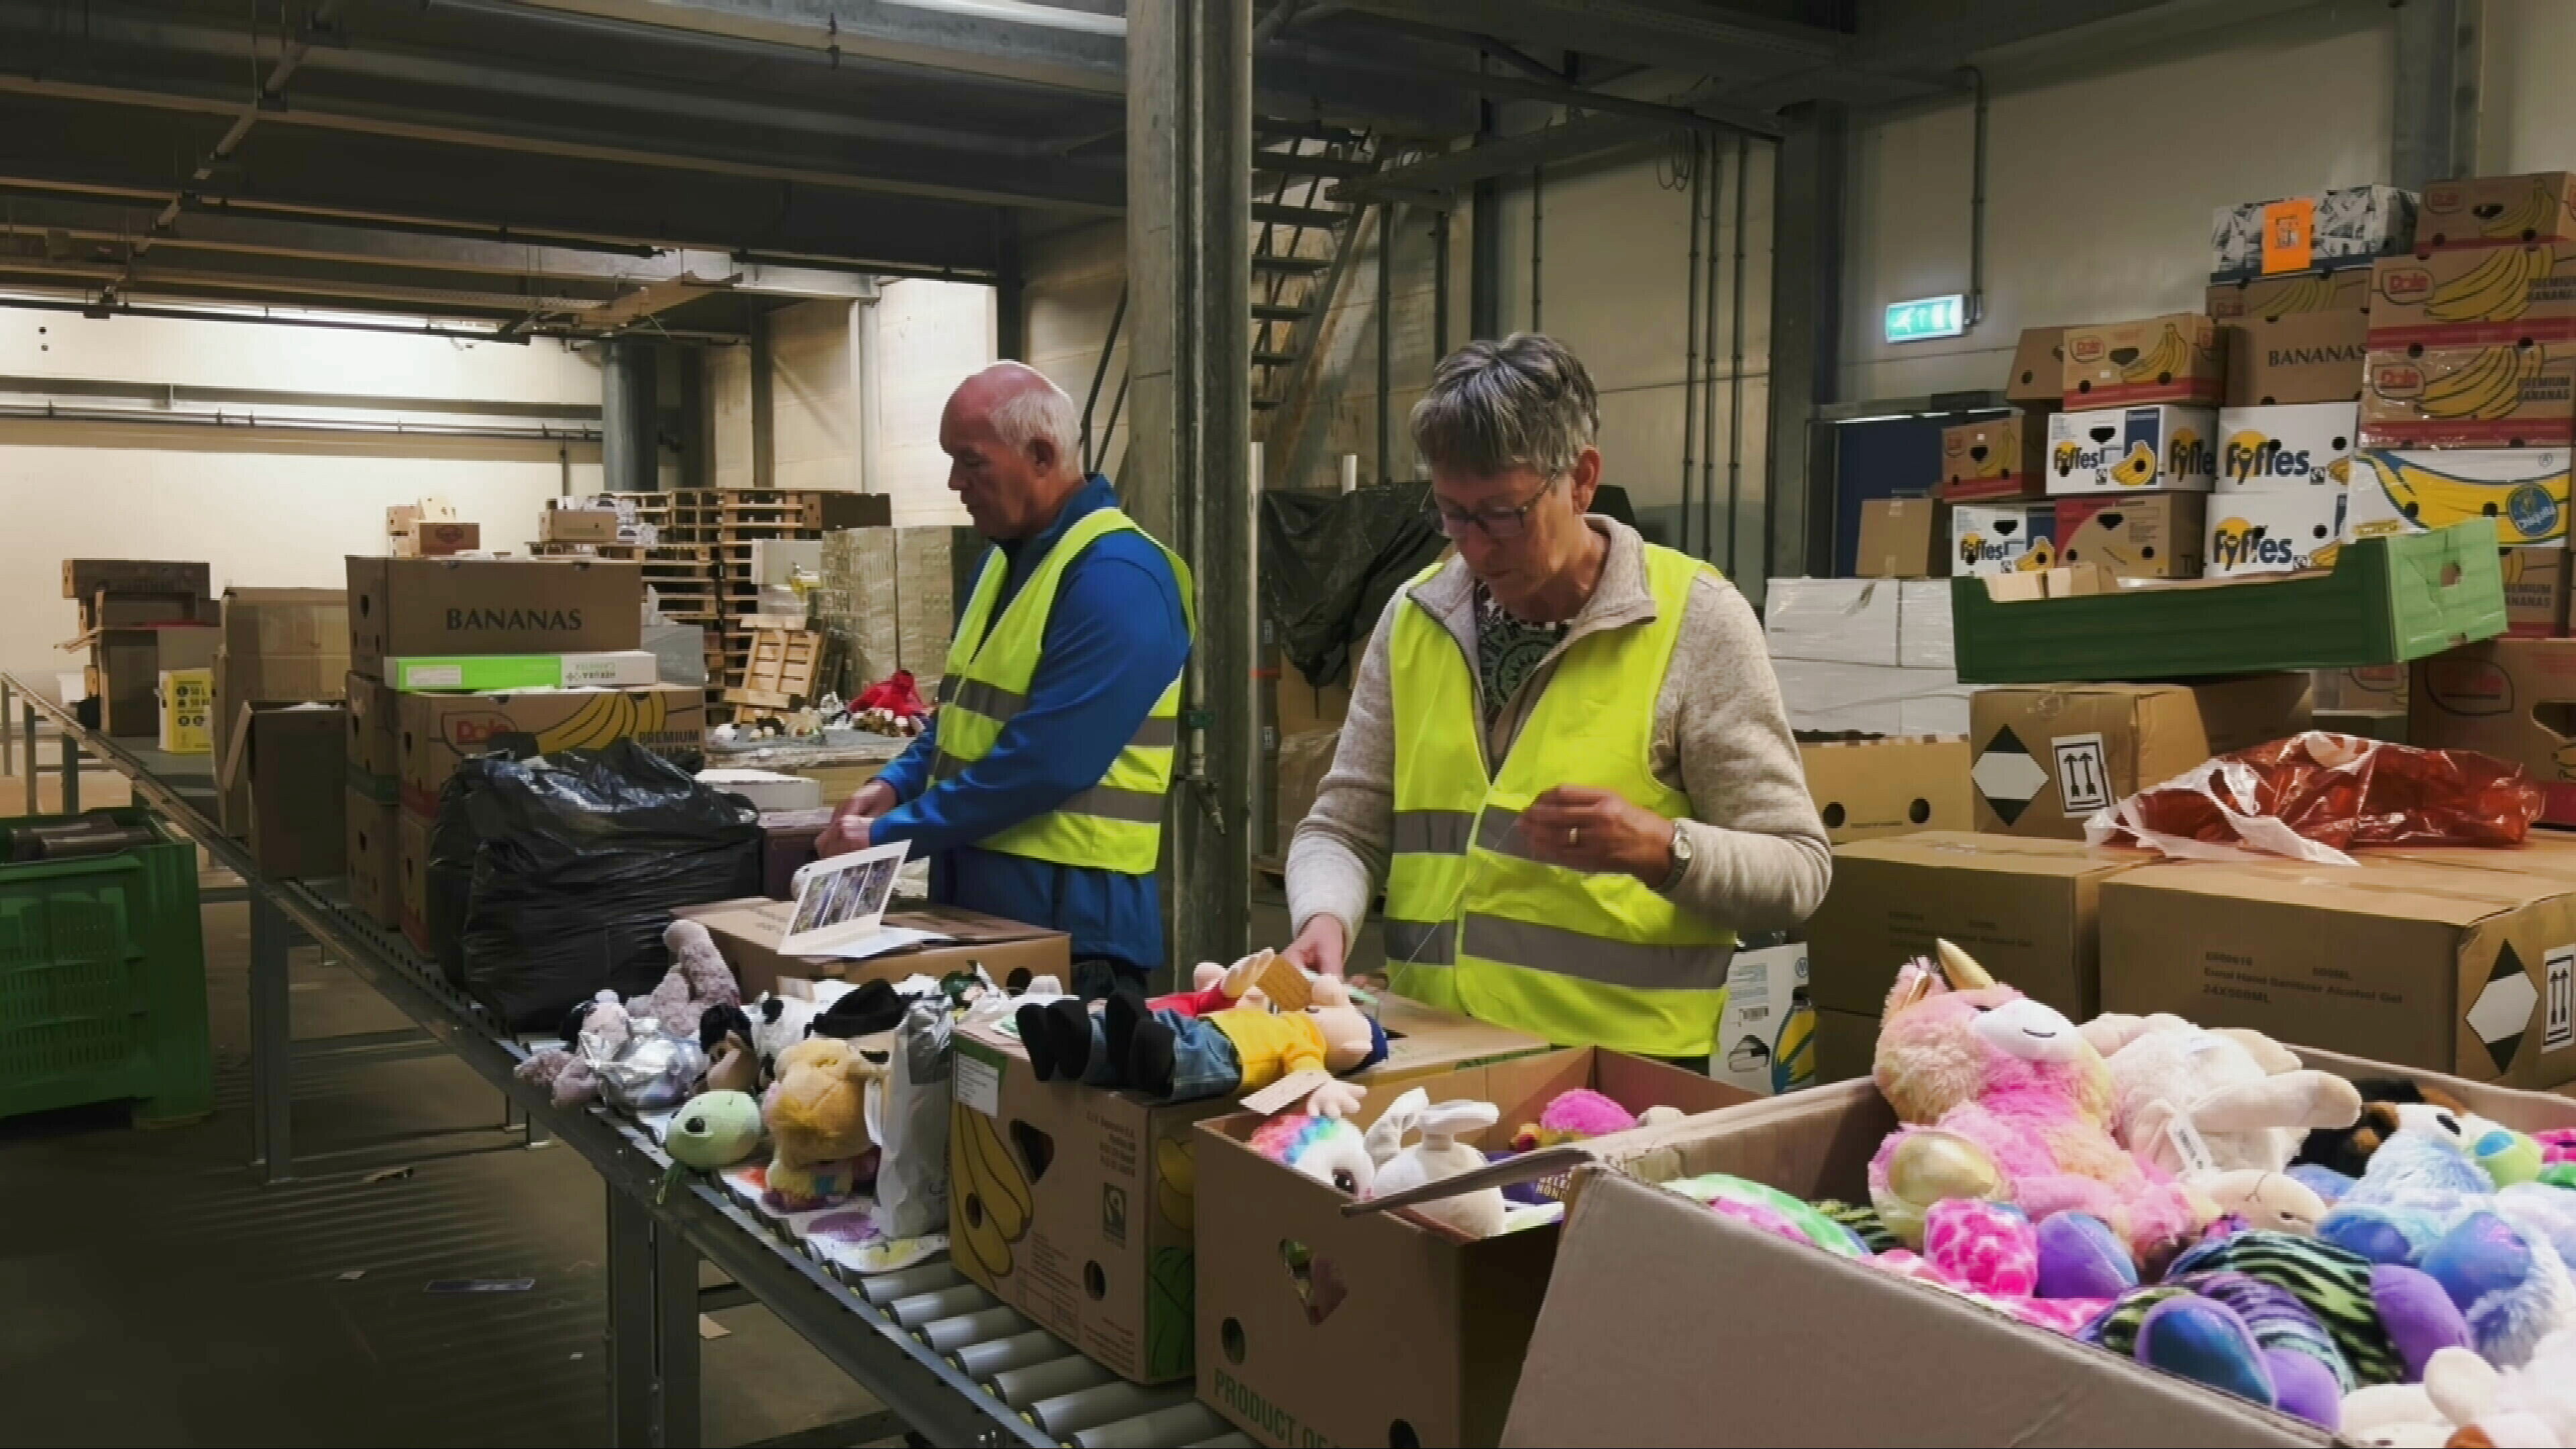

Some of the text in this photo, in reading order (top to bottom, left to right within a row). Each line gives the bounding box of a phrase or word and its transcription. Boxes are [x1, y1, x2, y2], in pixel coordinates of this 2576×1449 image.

[2268, 344, 2367, 366] BANANAS
[447, 608, 582, 630] BANANAS
[639, 731, 699, 743] PREMIUM
[1214, 1368, 1296, 1446] PRODUCT
